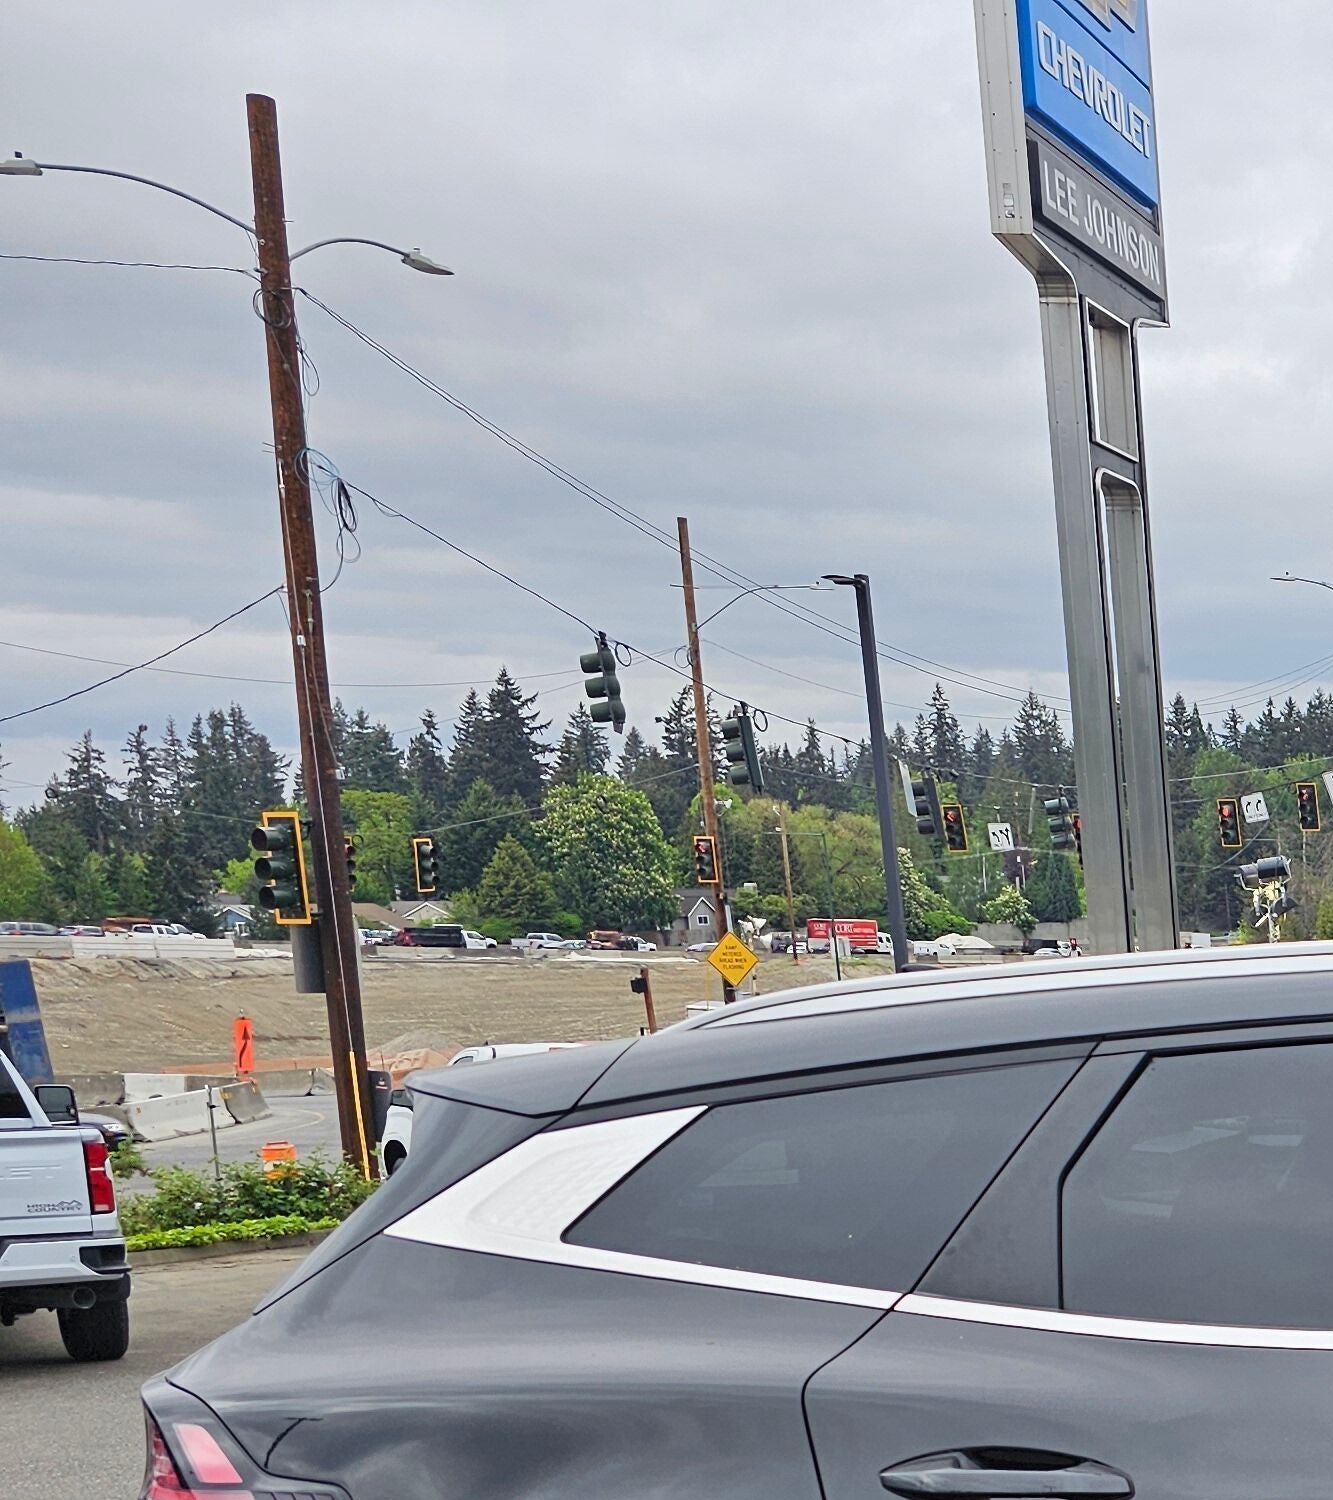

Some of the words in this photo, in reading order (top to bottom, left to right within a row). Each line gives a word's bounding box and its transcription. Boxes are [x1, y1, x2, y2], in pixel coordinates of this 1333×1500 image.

[1037, 20, 1150, 159] CHEVROLET
[1044, 160, 1079, 226] LEE
[1084, 193, 1160, 285] JOHNSON
[27, 1206, 82, 1214] COUNTRY
